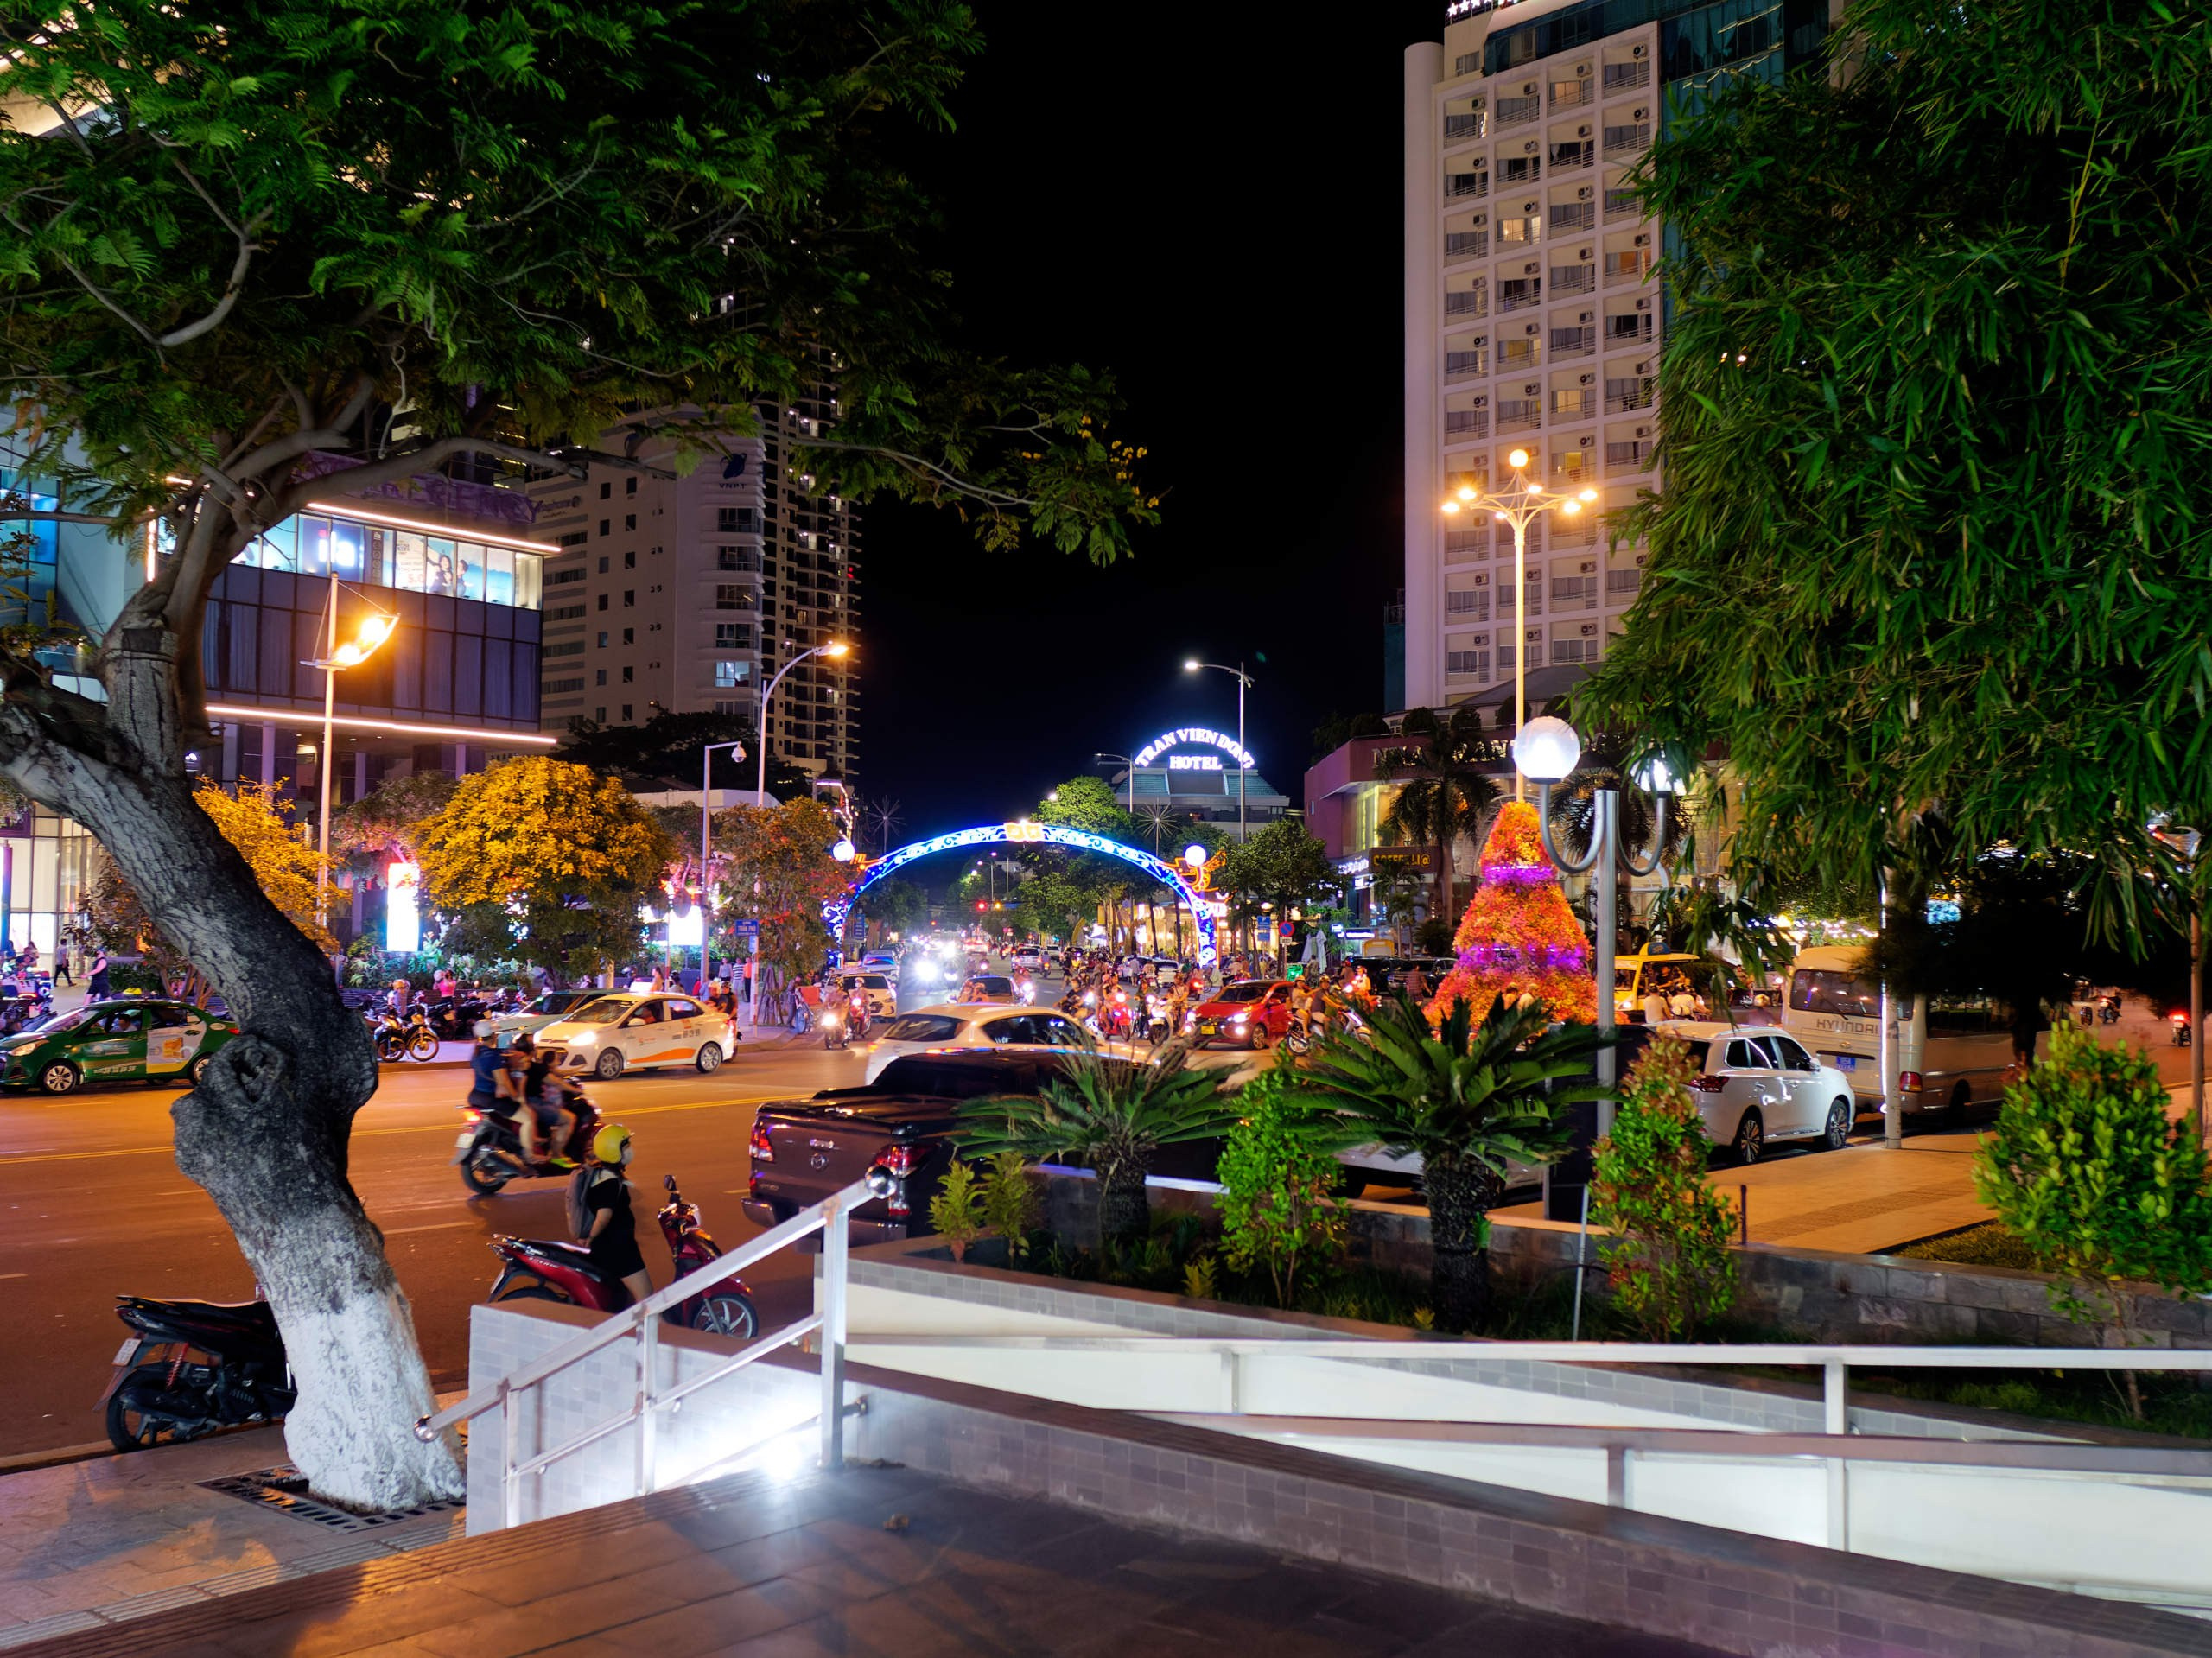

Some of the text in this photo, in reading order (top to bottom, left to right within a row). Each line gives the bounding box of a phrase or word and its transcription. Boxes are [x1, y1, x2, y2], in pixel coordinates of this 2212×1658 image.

[1135, 732, 1177, 767] TRAN
[1176, 727, 1218, 745] VIEN
[1169, 755, 1223, 770] HOTEL
[1816, 1019, 1878, 1035] HYUNDAI
